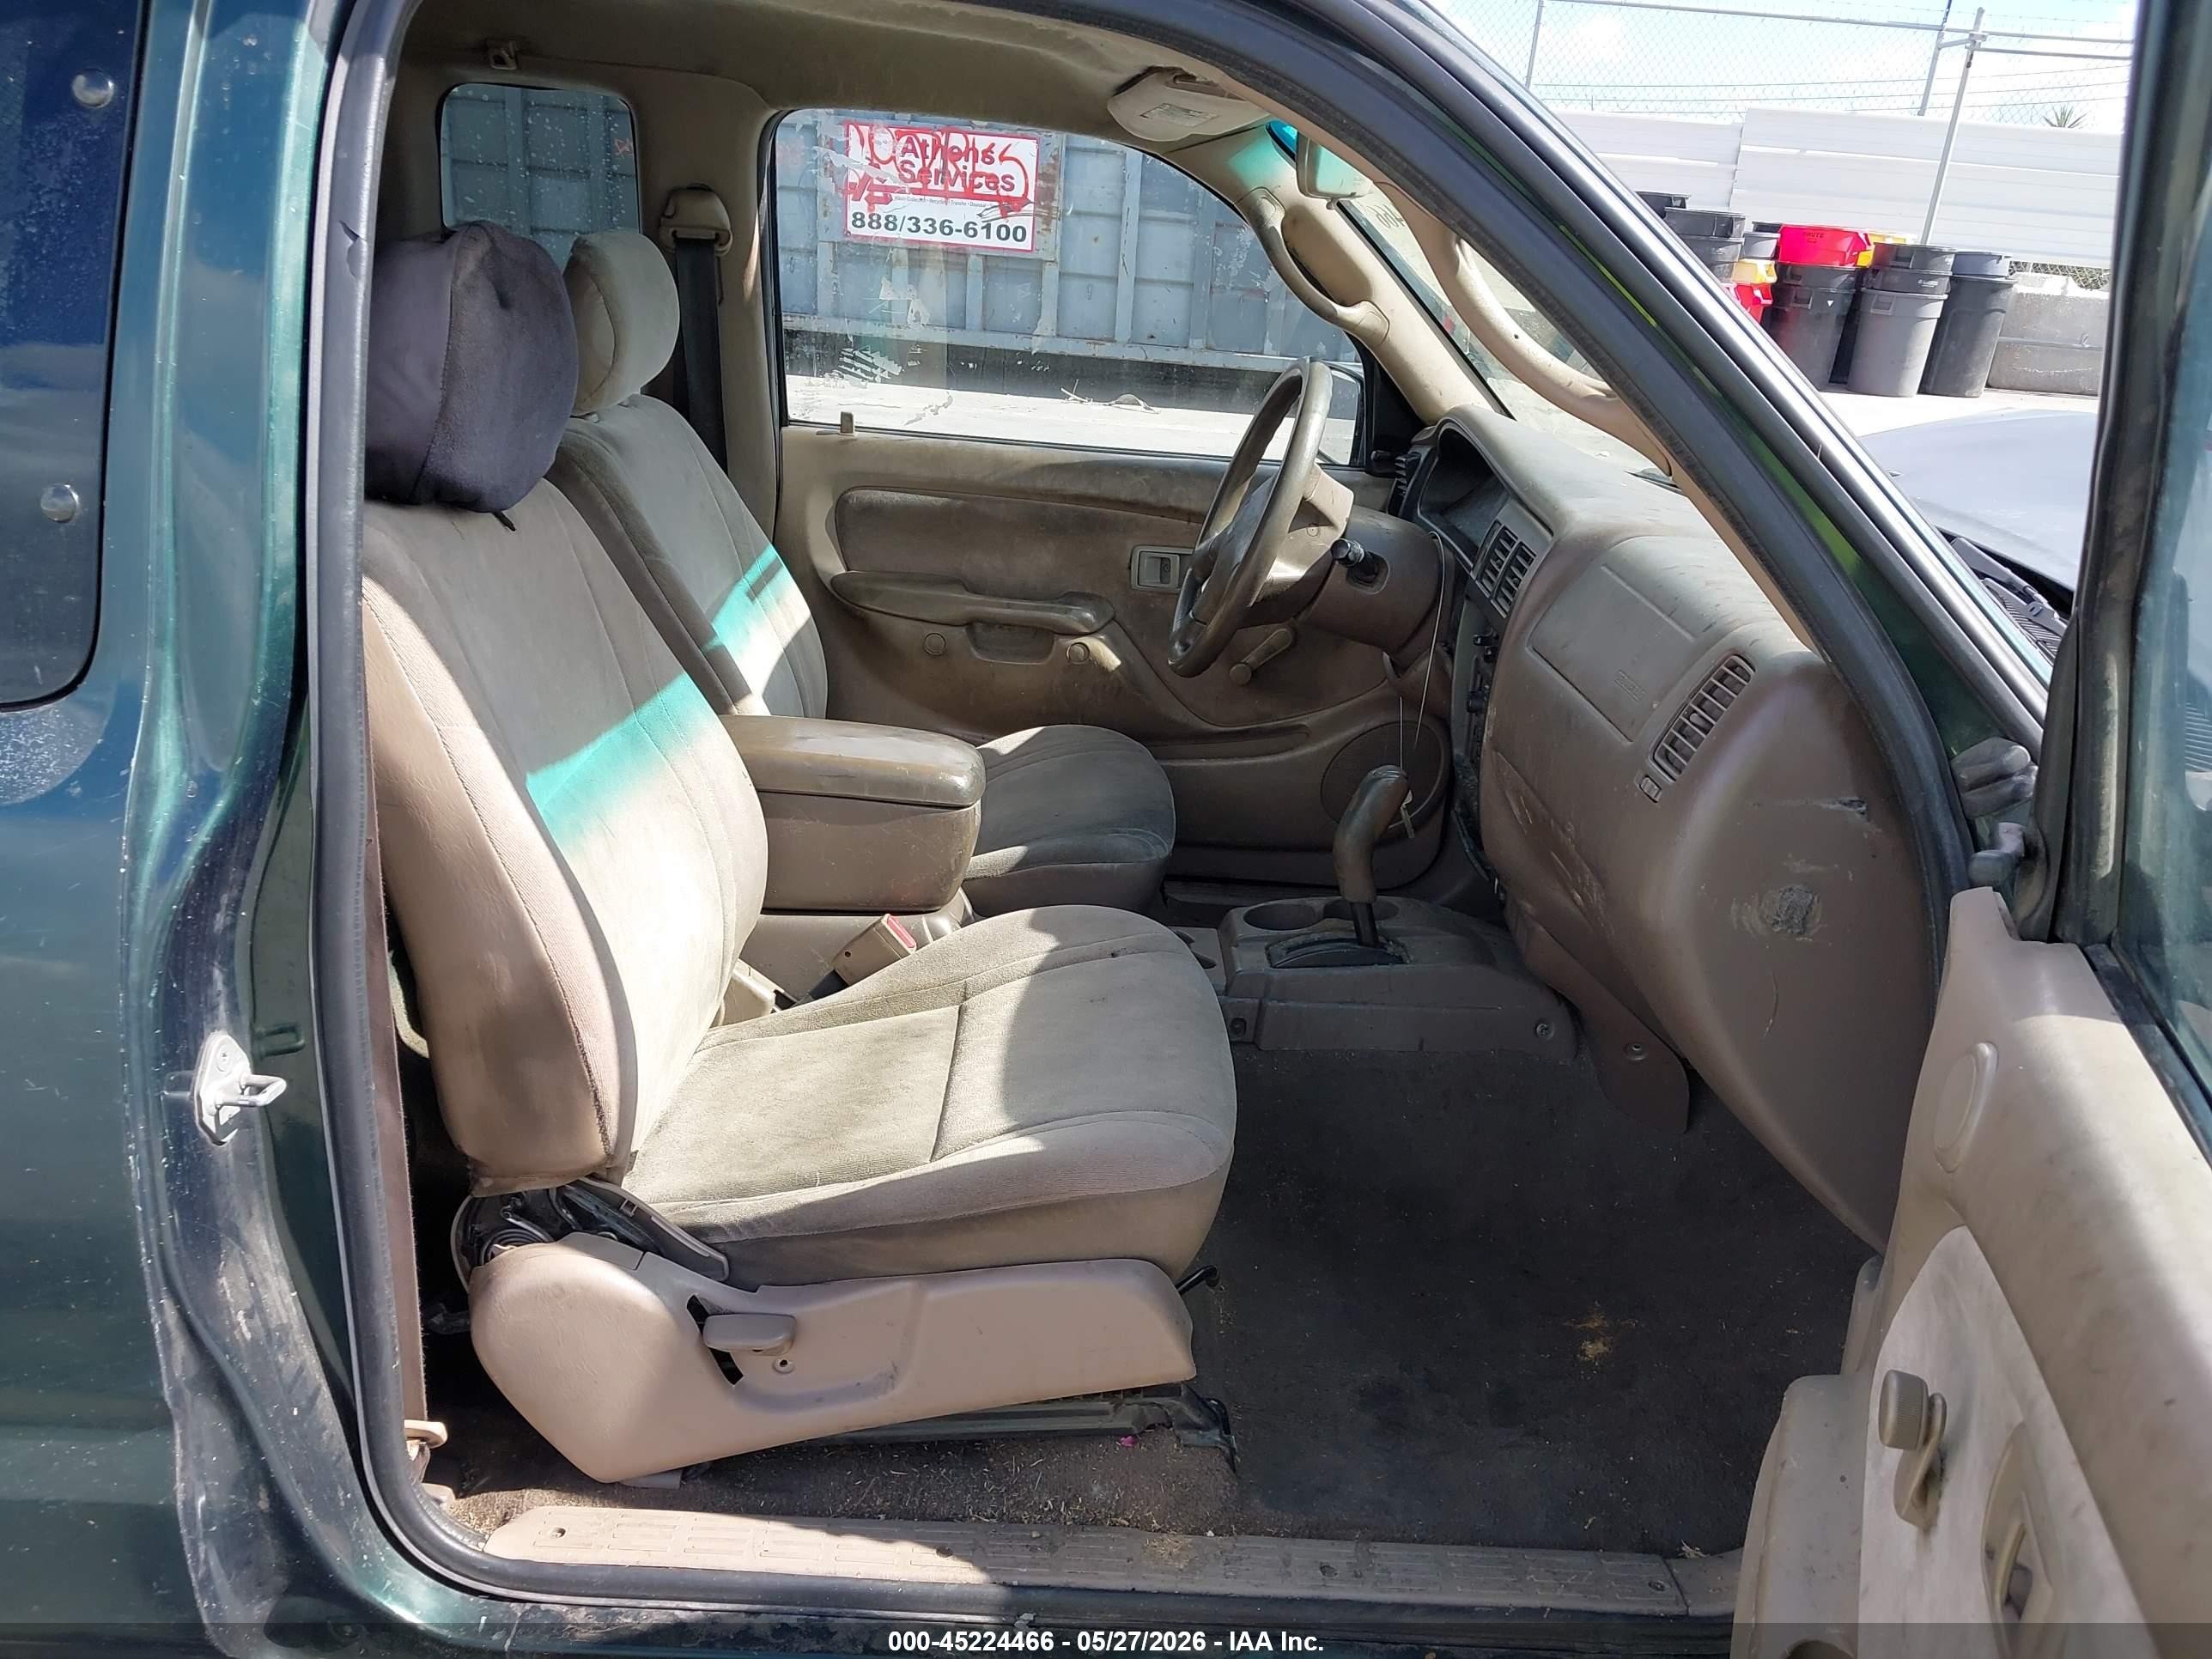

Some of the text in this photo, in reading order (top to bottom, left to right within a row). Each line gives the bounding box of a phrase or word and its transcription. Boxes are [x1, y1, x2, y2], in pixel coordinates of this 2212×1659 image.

[901, 137, 995, 165] Athens
[900, 160, 1016, 193] Services
[851, 211, 1027, 243] 888/336-6100
